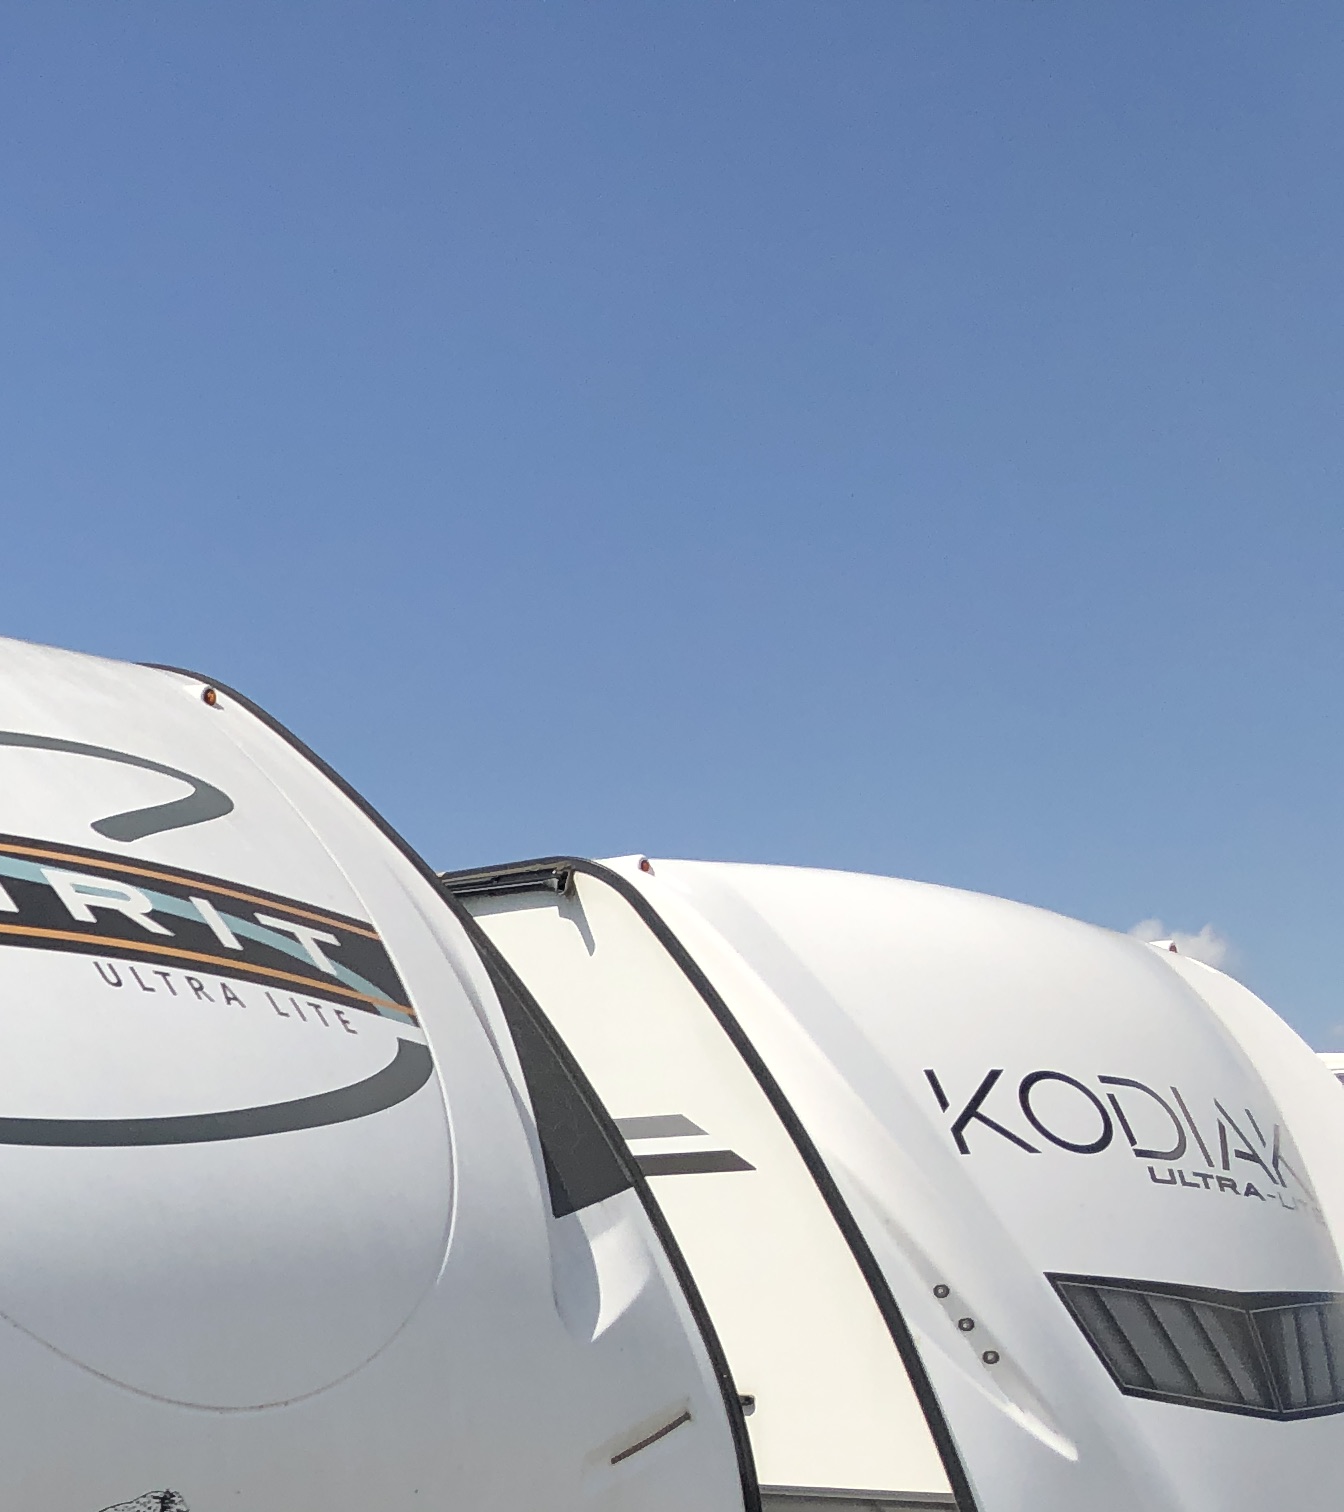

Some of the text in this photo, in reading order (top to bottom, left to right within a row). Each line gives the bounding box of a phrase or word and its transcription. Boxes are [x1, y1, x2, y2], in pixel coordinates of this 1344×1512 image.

[92, 960, 359, 1035] ULTRA LITE
[923, 1068, 1315, 1200] KODIAK
